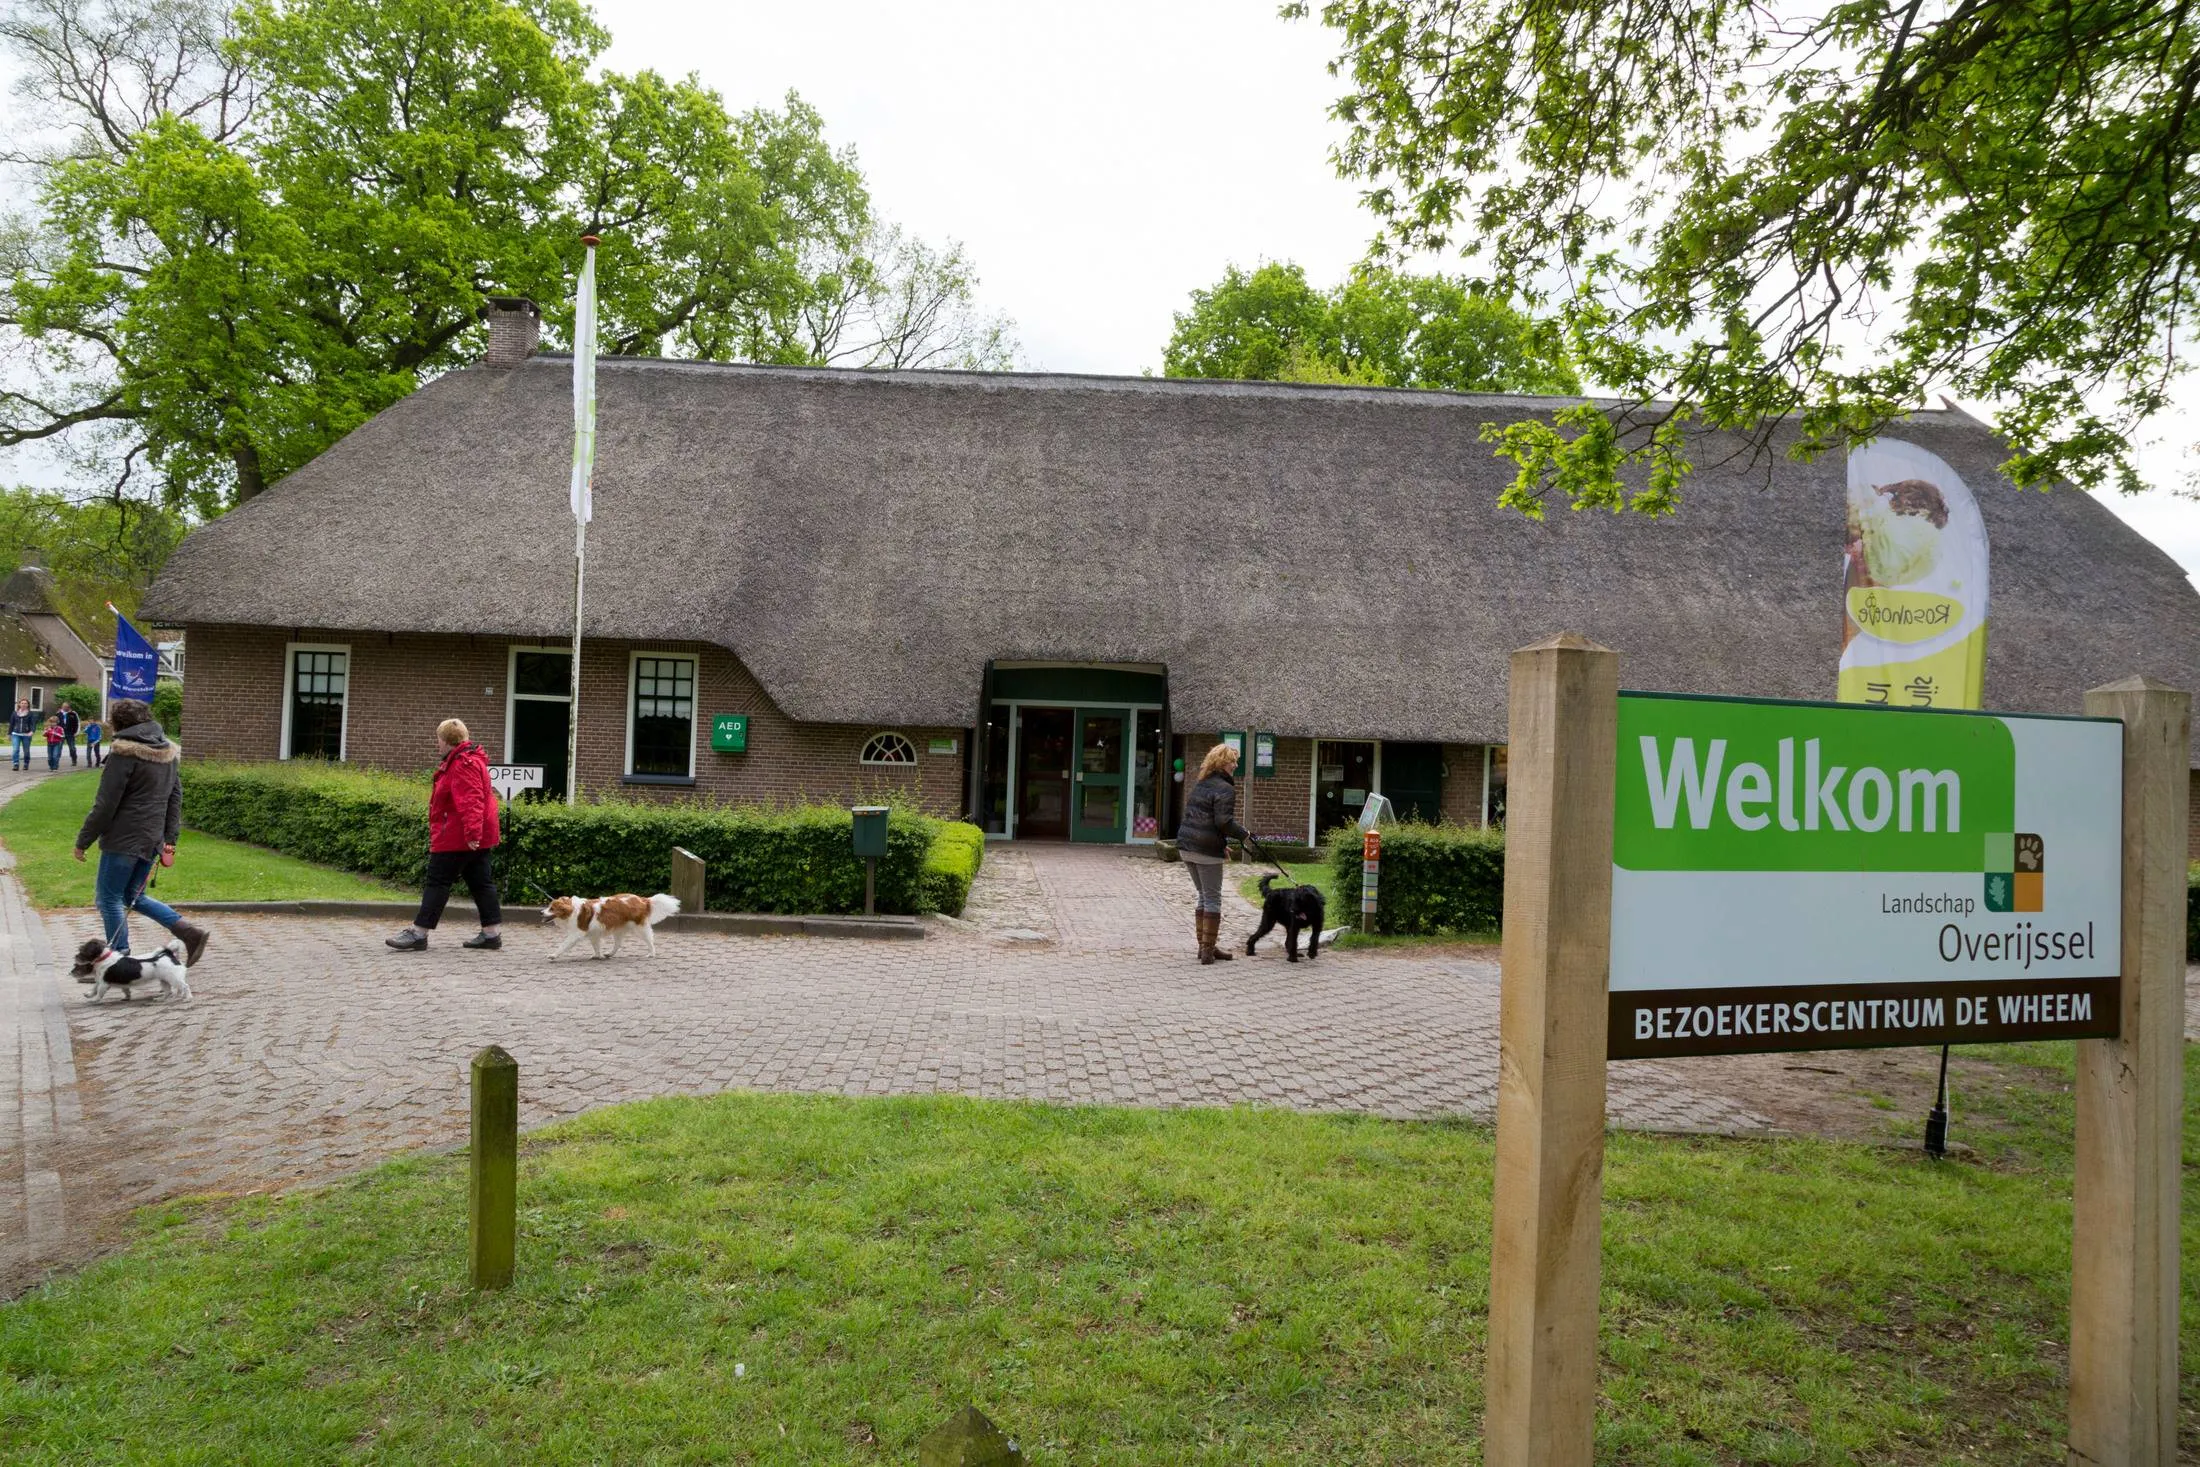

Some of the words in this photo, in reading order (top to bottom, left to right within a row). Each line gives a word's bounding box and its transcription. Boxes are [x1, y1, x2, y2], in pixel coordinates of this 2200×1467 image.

[718, 721, 741, 731] AED
[488, 767, 535, 781] OPEN
[1639, 735, 1961, 833] Welkom
[1882, 892, 1976, 918] Landschap
[1938, 921, 2095, 970] Overijssel
[1634, 997, 1945, 1040] BEZOEKERSCENTRUM
[1956, 996, 1988, 1027] DE
[1997, 993, 2093, 1025] WHEEM
